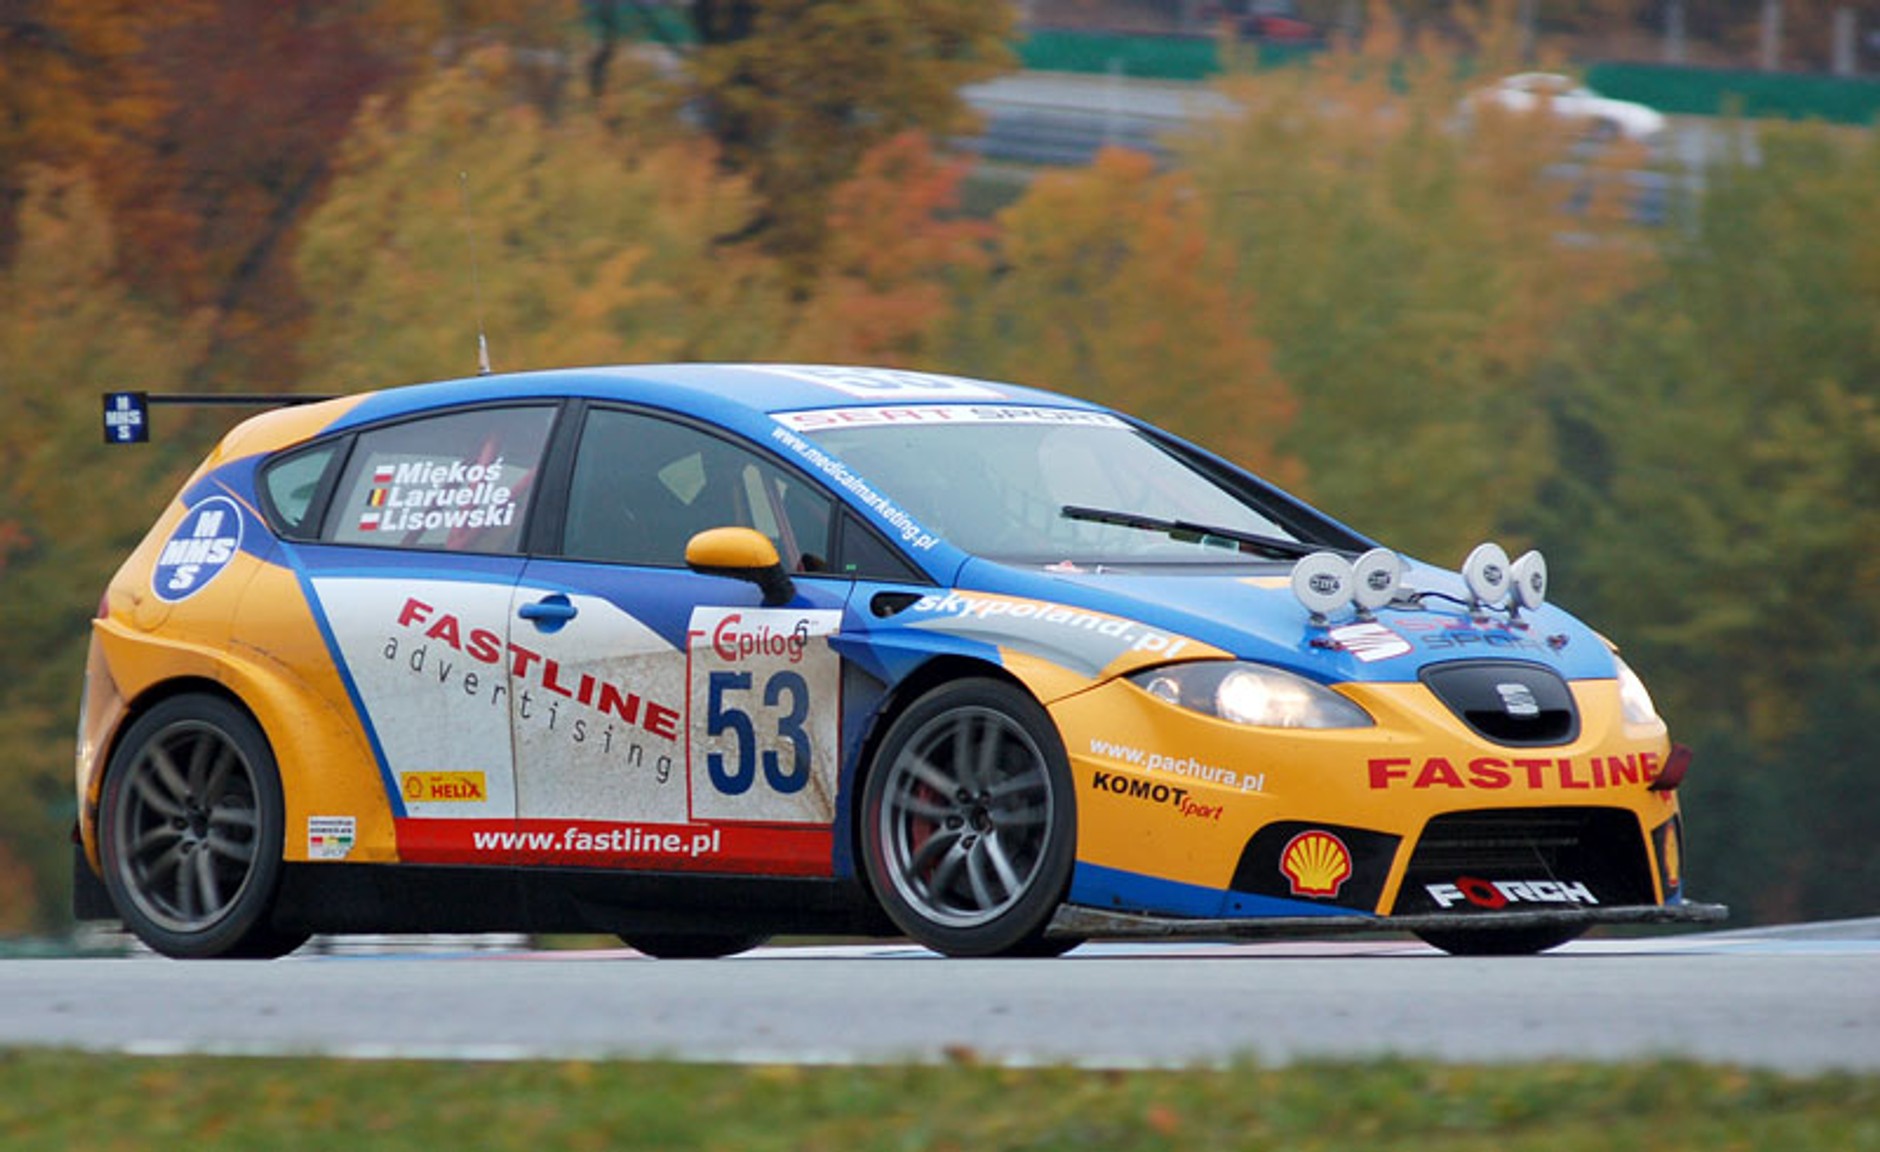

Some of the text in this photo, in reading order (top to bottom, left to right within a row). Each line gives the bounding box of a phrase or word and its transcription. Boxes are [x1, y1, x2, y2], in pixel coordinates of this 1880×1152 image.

[793, 408, 1112, 427] SEAT SPORT
[395, 456, 503, 488] Miękoś
[772, 427, 940, 550] www.medicalmarketing.pl
[387, 482, 511, 508] Laruelle
[380, 503, 515, 531] Lisowski
[168, 565, 199, 589] S
[714, 614, 803, 663] Epilog
[913, 591, 1187, 659] skypoland.pl
[397, 597, 680, 742] FASTLINE
[383, 637, 672, 784] advertising
[707, 670, 811, 795] 53
[1090, 738, 1265, 793] www.pachura.pl
[1368, 752, 1658, 790] FASTLINE
[473, 827, 720, 857] www.fastline.pl
